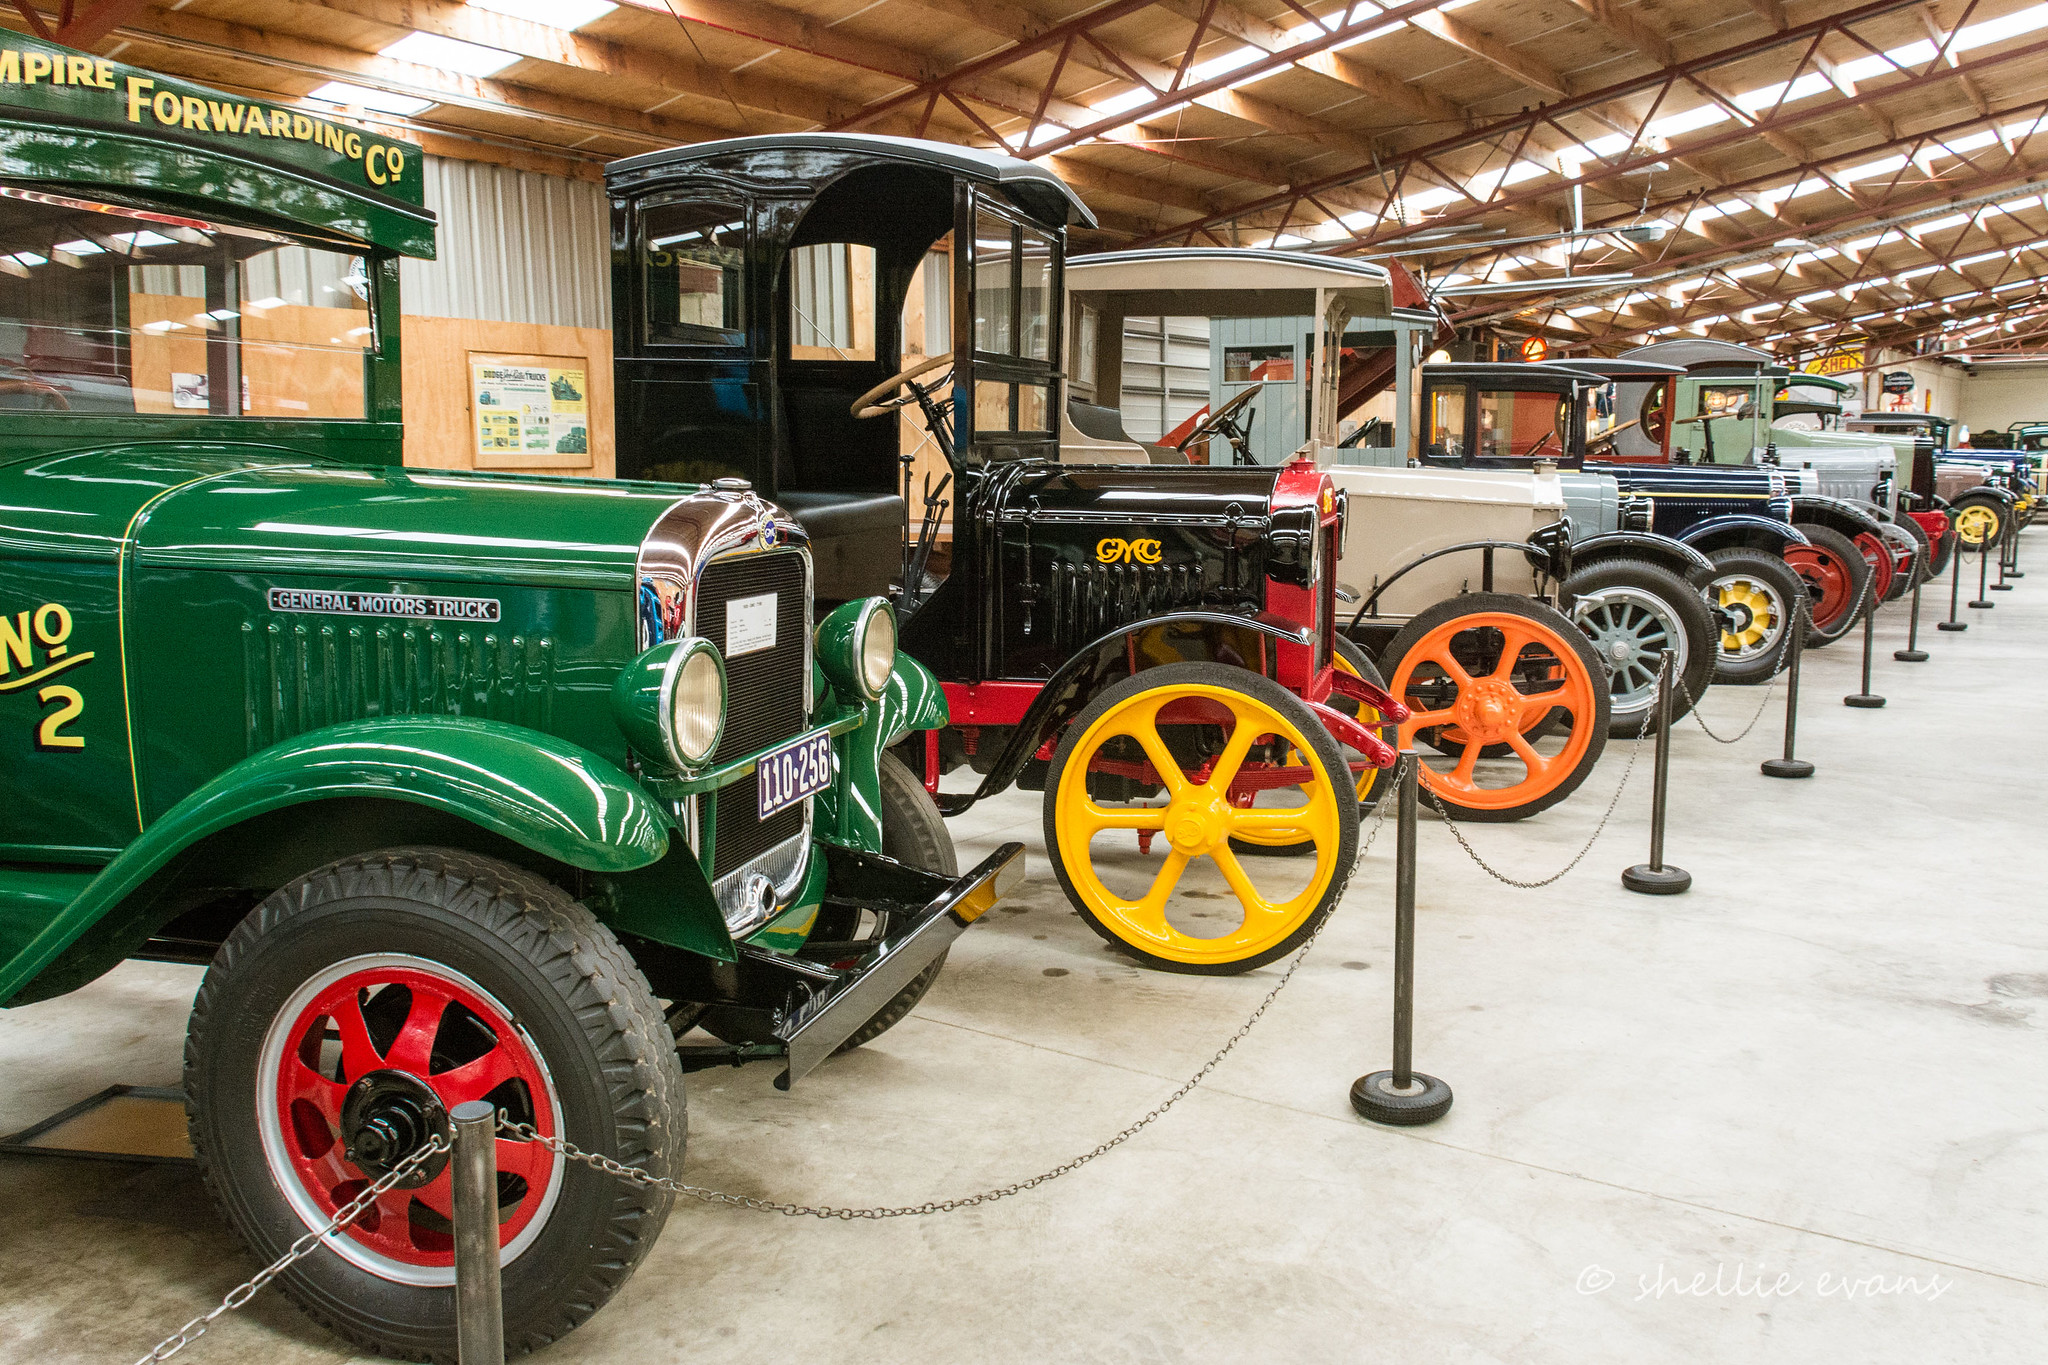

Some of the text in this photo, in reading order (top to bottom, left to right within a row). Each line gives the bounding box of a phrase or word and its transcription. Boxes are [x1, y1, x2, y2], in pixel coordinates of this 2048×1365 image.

[127, 76, 363, 159] FORWARDING
[1096, 538, 1163, 564] GMC
[278, 592, 490, 618] GENERAL MOTORS TRUCK
[38, 684, 85, 748] 2
